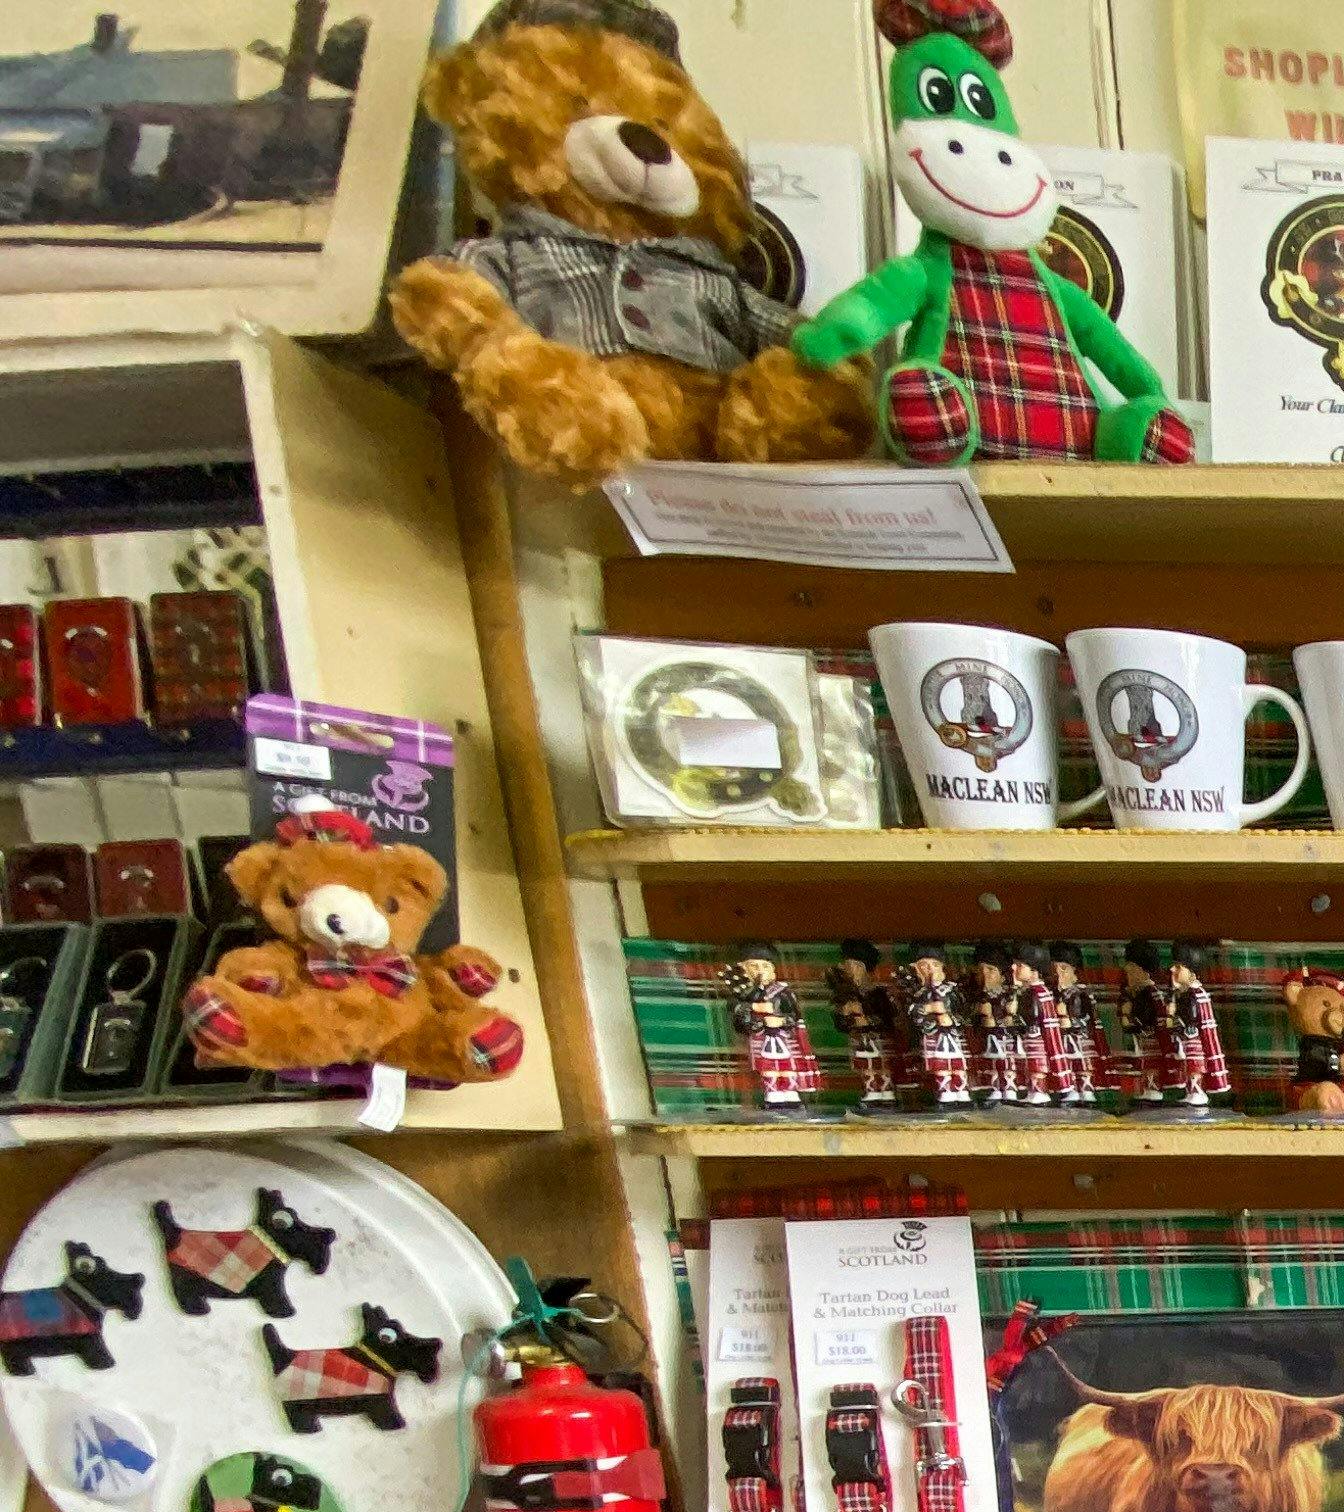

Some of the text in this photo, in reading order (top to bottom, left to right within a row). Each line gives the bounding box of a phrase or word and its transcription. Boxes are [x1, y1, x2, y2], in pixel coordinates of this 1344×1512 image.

[1280, 396, 1312, 416] Your
[926, 773, 1020, 804] MACLEAN
[1190, 787, 1226, 815] NSW
[838, 1252, 928, 1269] SCOTLAND
[819, 1286, 950, 1305] Tartan Dog Lead
[813, 1301, 958, 1319] & Matching Collar
[835, 1332, 855, 1344] 911
[828, 1345, 866, 1357] $18.00
